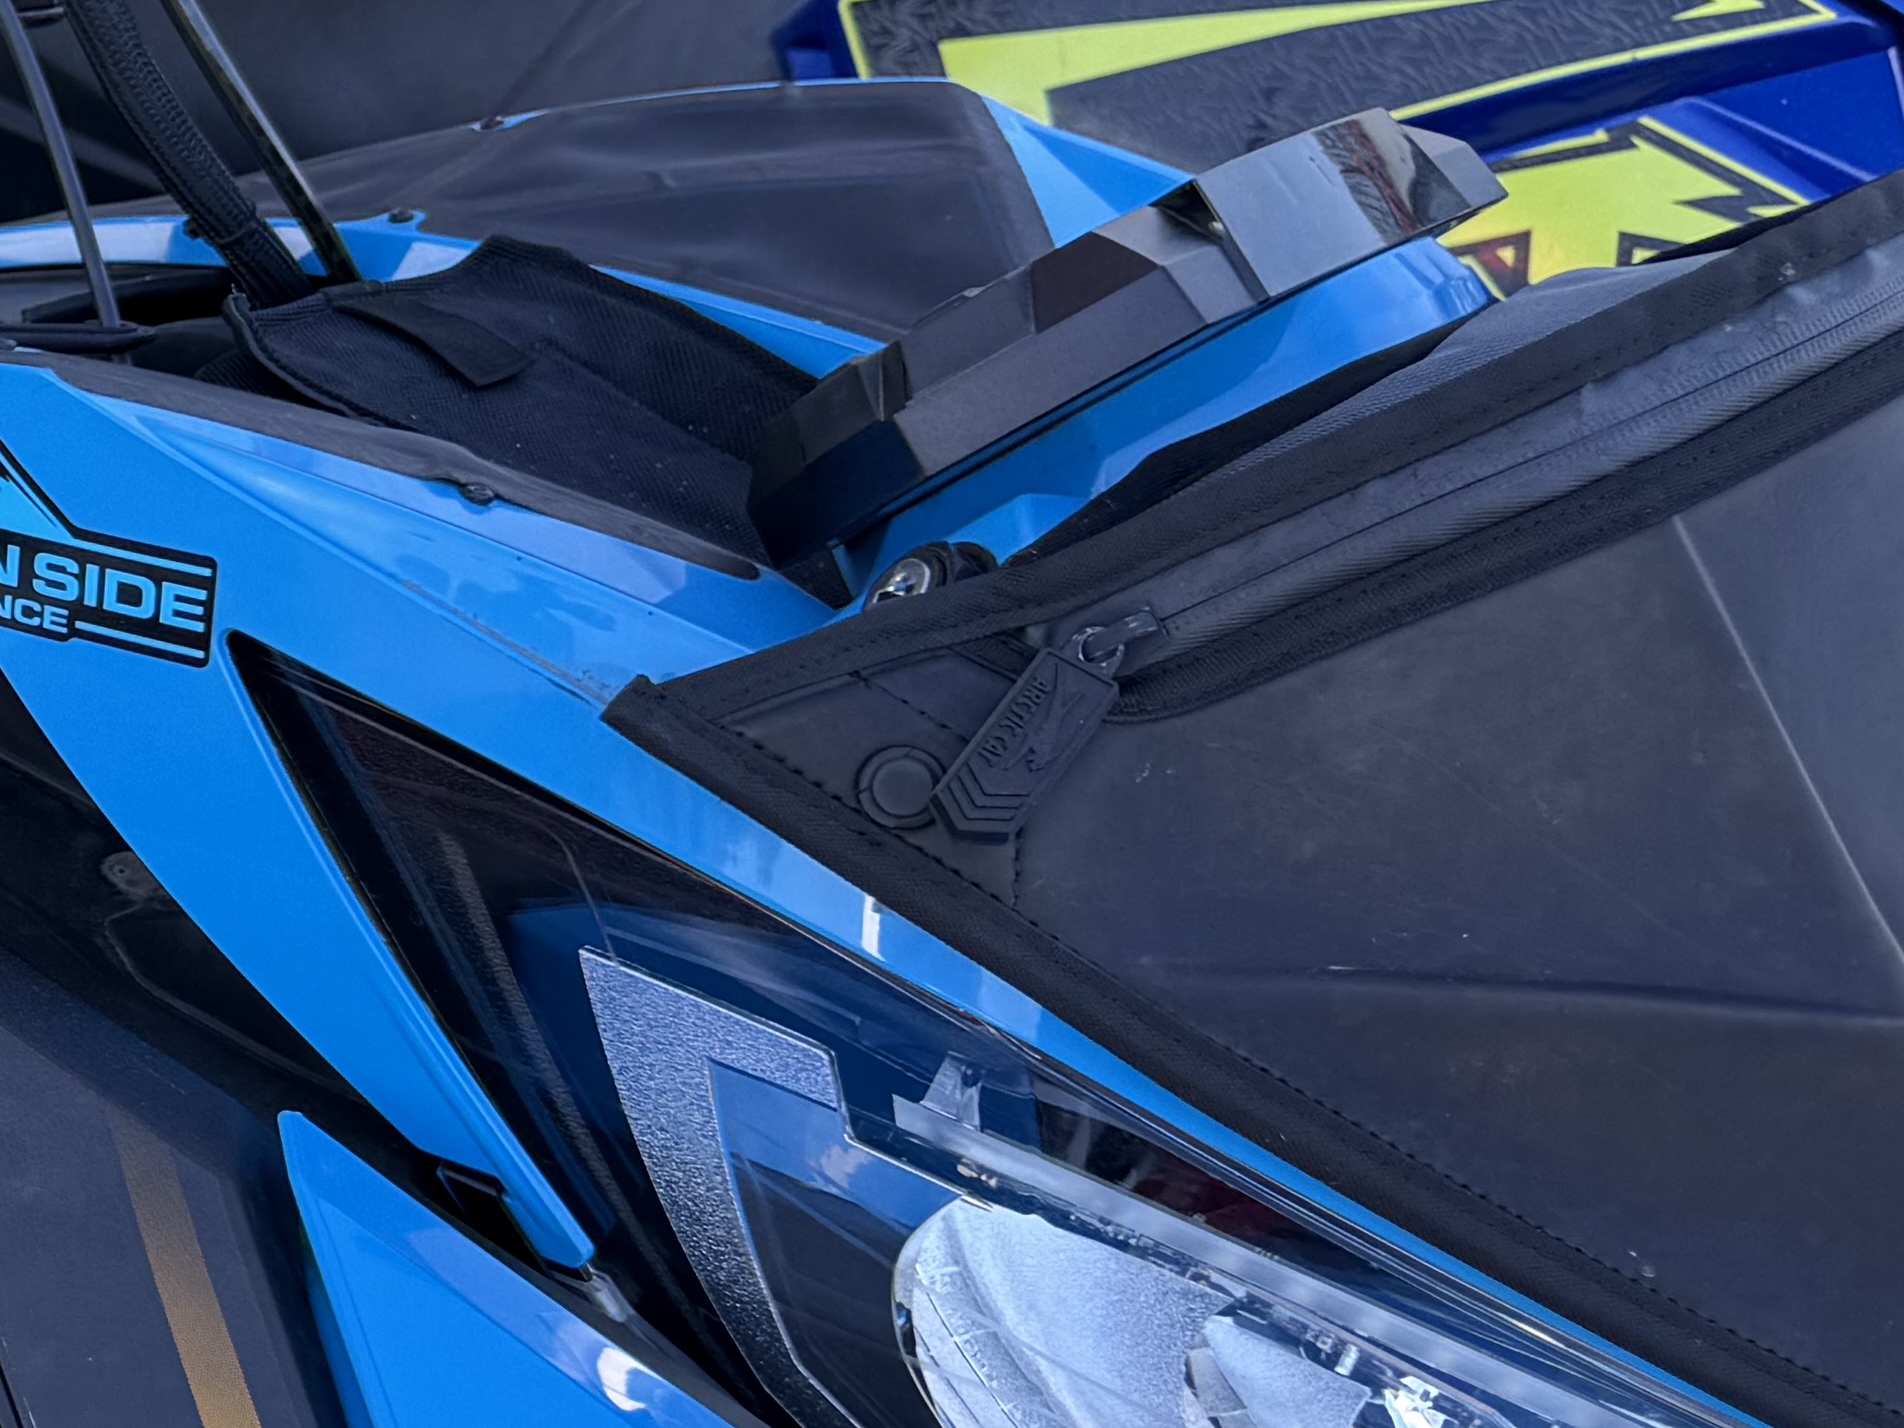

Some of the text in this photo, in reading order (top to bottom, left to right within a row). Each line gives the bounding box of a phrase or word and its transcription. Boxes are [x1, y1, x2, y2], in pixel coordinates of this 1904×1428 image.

[32, 552, 207, 632] SIDE
[977, 677, 1050, 769] ARCTIC CAT
